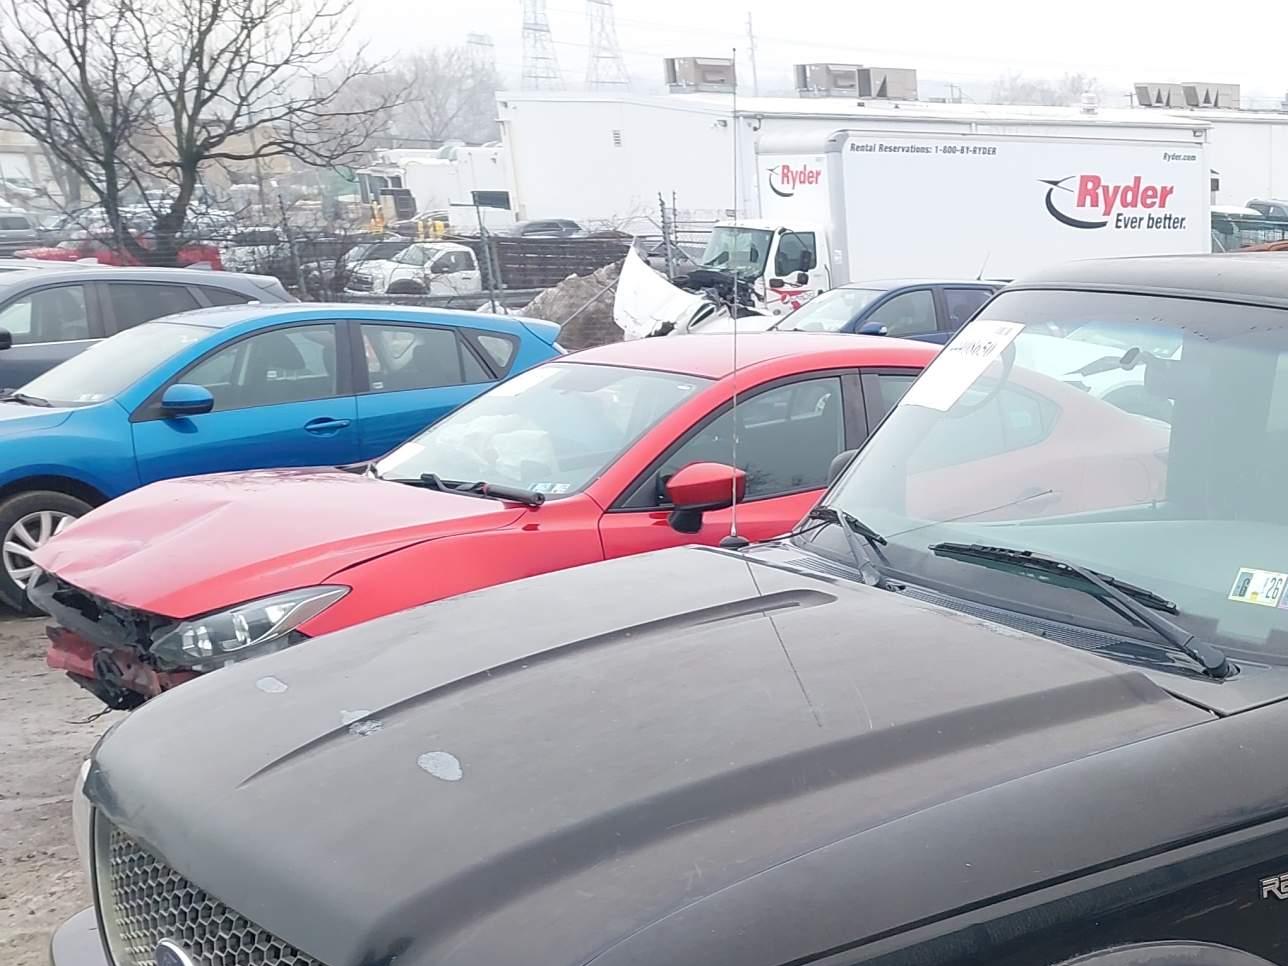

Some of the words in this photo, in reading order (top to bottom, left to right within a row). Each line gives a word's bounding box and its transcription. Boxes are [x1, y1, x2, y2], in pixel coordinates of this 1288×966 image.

[850, 143, 876, 152] Rental
[879, 144, 932, 154] Reservations:
[1163, 152, 1196, 162] Ryder.com
[781, 164, 822, 190] Ryder
[1076, 175, 1174, 216] Ryder
[1115, 213, 1144, 229] Ever
[1147, 213, 1186, 230] better.
